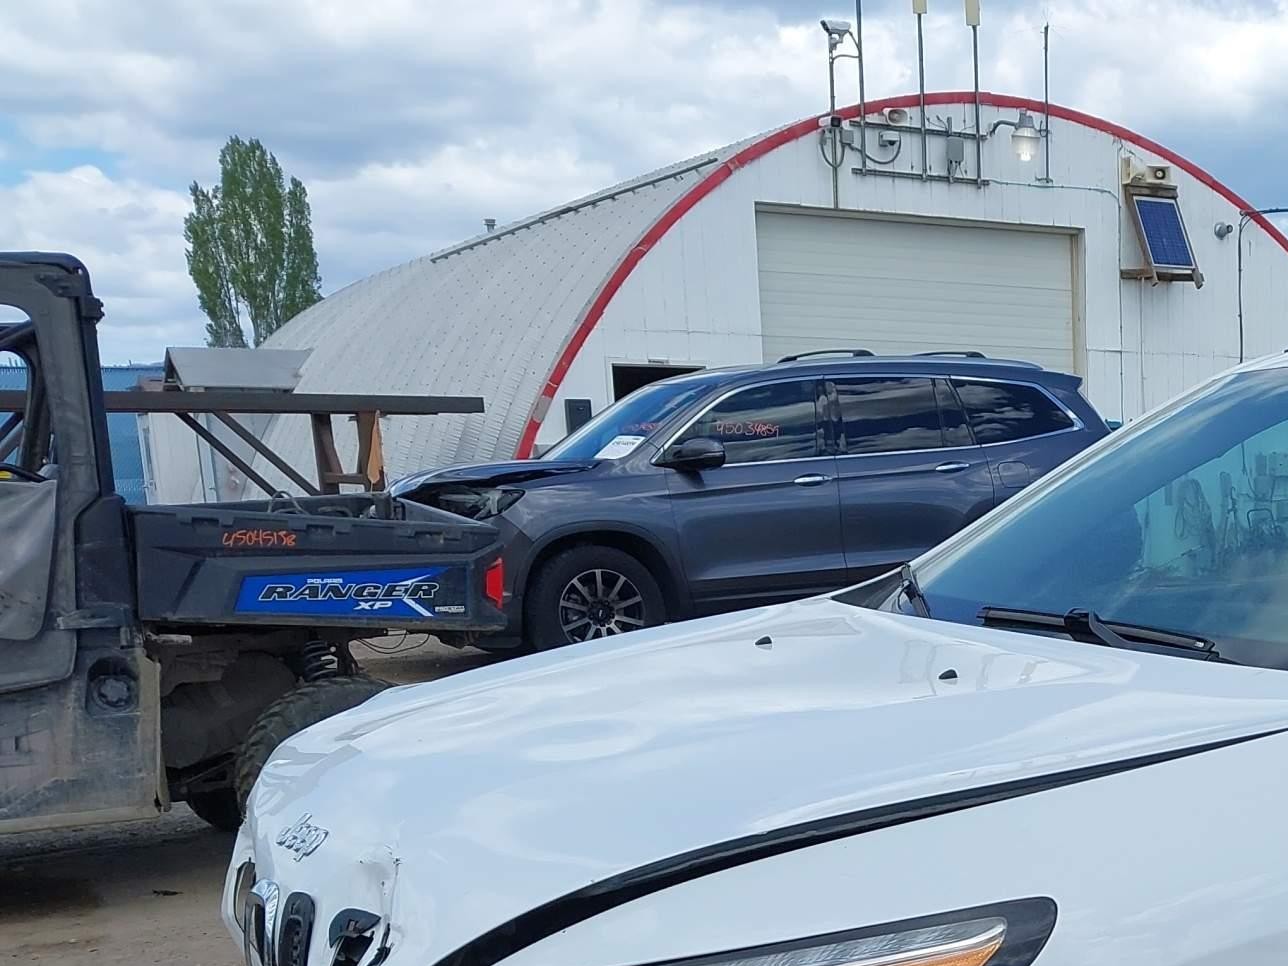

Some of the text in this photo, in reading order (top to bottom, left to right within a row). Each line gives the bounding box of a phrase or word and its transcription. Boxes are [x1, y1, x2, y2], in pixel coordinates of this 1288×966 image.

[258, 582, 440, 602] RANGER
[353, 600, 393, 610] XP
[275, 812, 330, 863] Jeep
